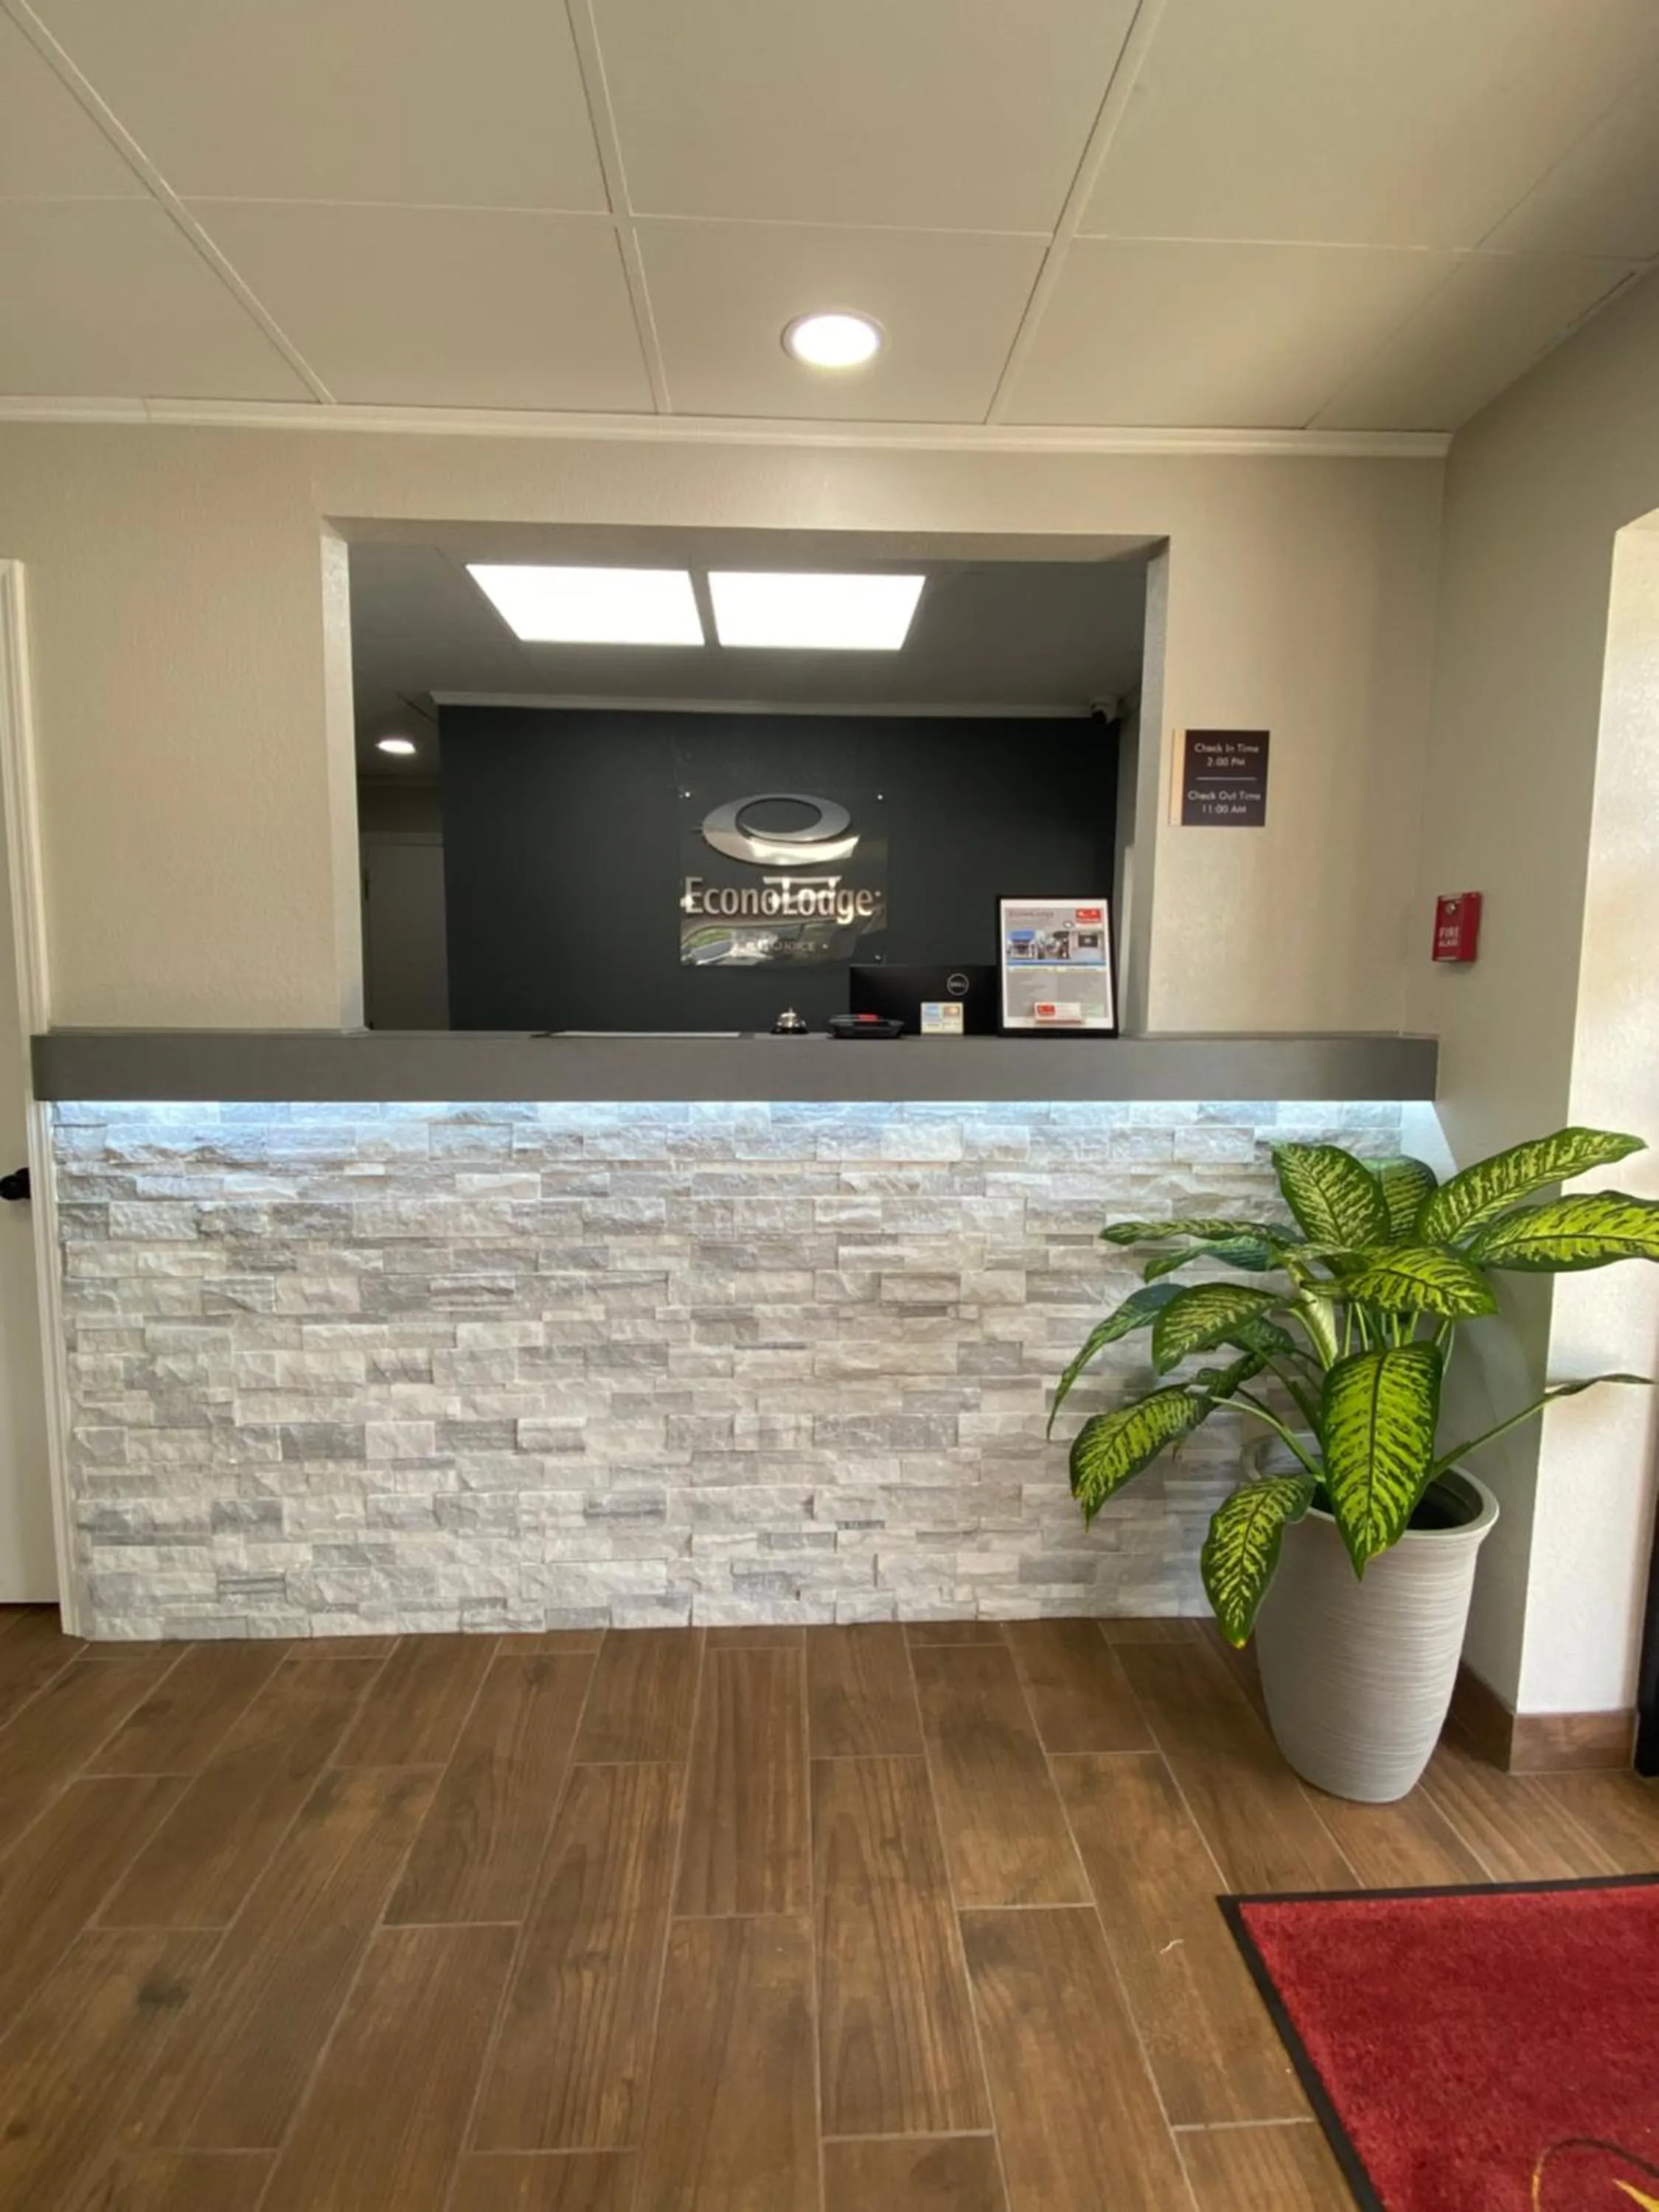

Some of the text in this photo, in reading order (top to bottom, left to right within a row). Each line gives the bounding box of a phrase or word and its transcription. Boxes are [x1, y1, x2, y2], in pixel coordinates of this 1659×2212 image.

[1194, 742, 1259, 754] Check In Time
[1187, 790, 1261, 801] Check Out Time
